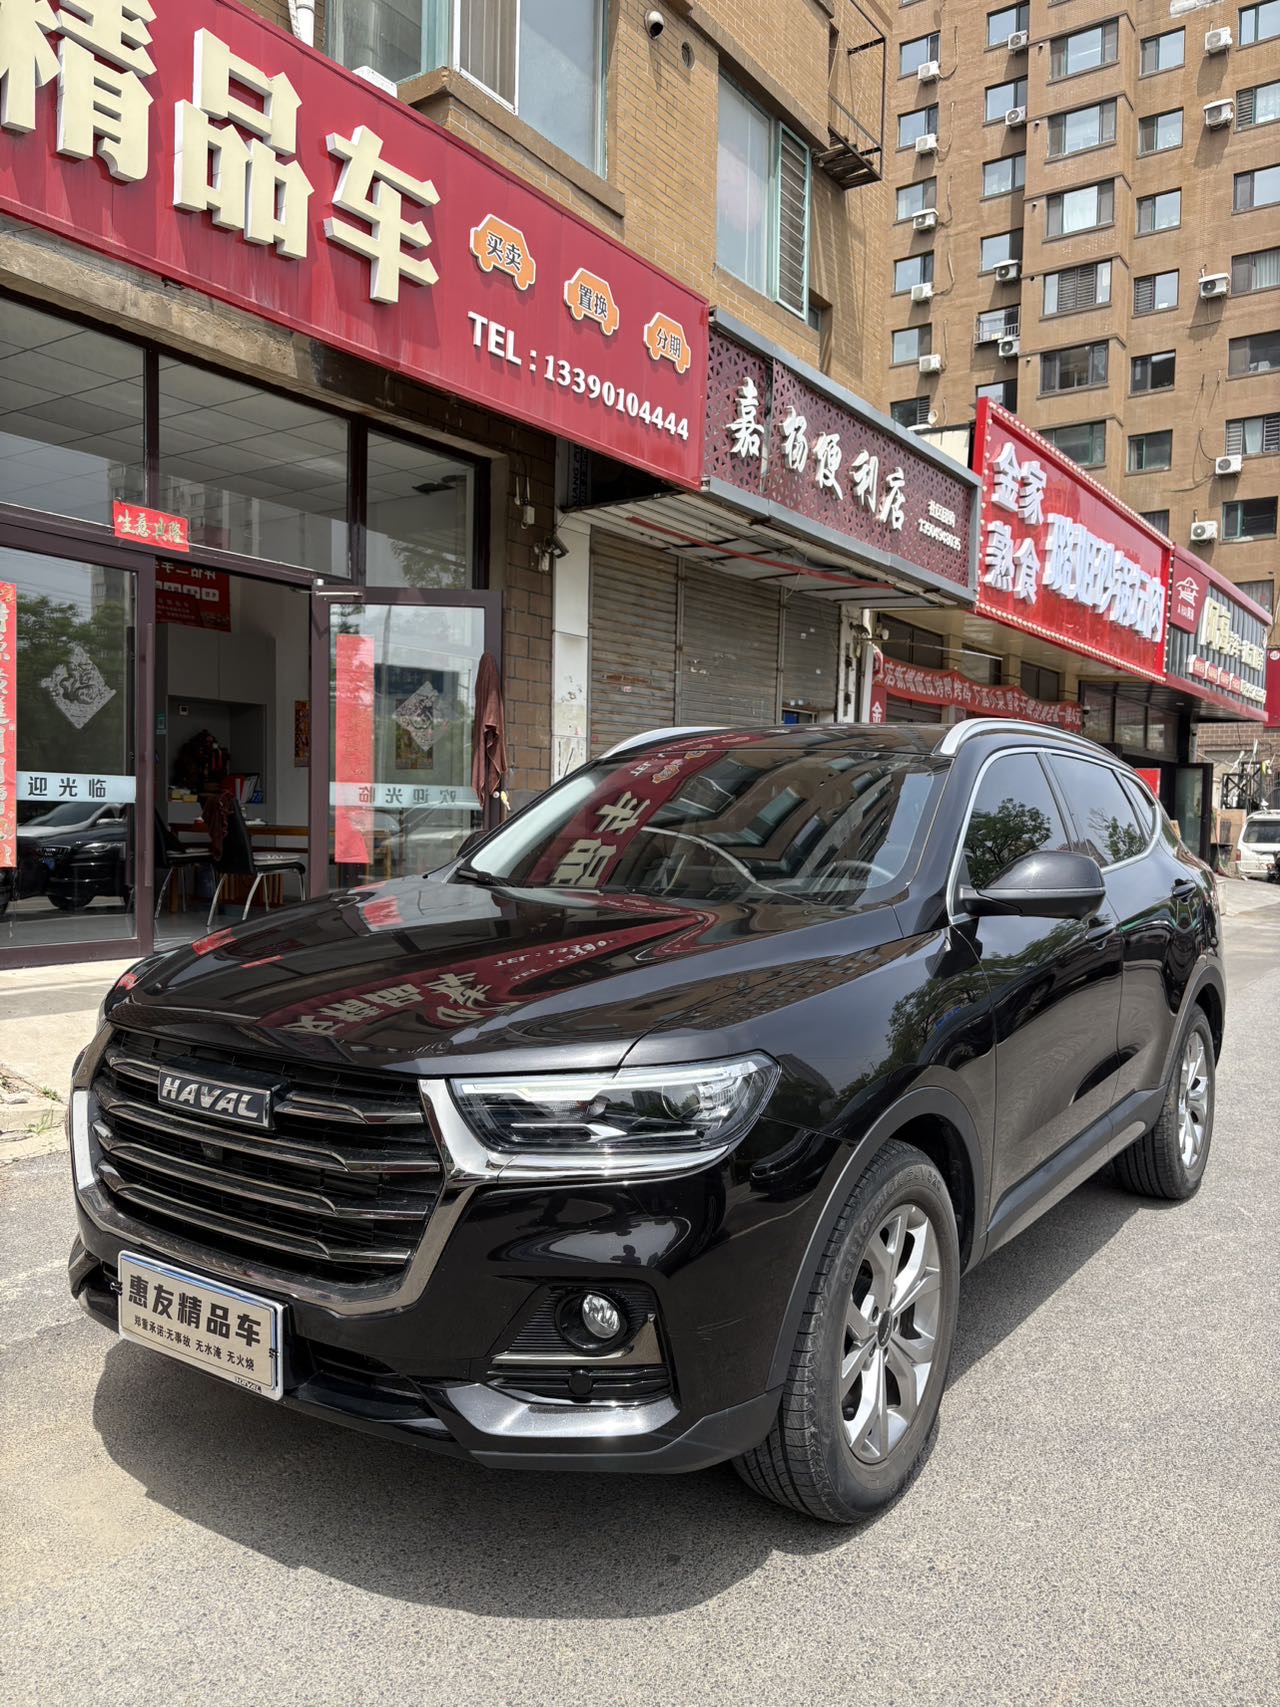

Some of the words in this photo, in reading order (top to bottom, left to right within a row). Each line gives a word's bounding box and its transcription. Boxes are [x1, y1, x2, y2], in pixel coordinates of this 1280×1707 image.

[487, 231, 523, 271] 买卖
[578, 283, 608, 318] 置换
[656, 327, 681, 358] 分期
[988, 441, 1047, 526] 金家
[984, 520, 1041, 605] 熟食
[28, 776, 107, 798] 迎光临
[162, 1077, 259, 1119] HAVAL
[128, 1274, 262, 1348] 惠友精品车
[195, 1339, 222, 1360] 无水淹
[226, 1350, 255, 1372] 无火烧
